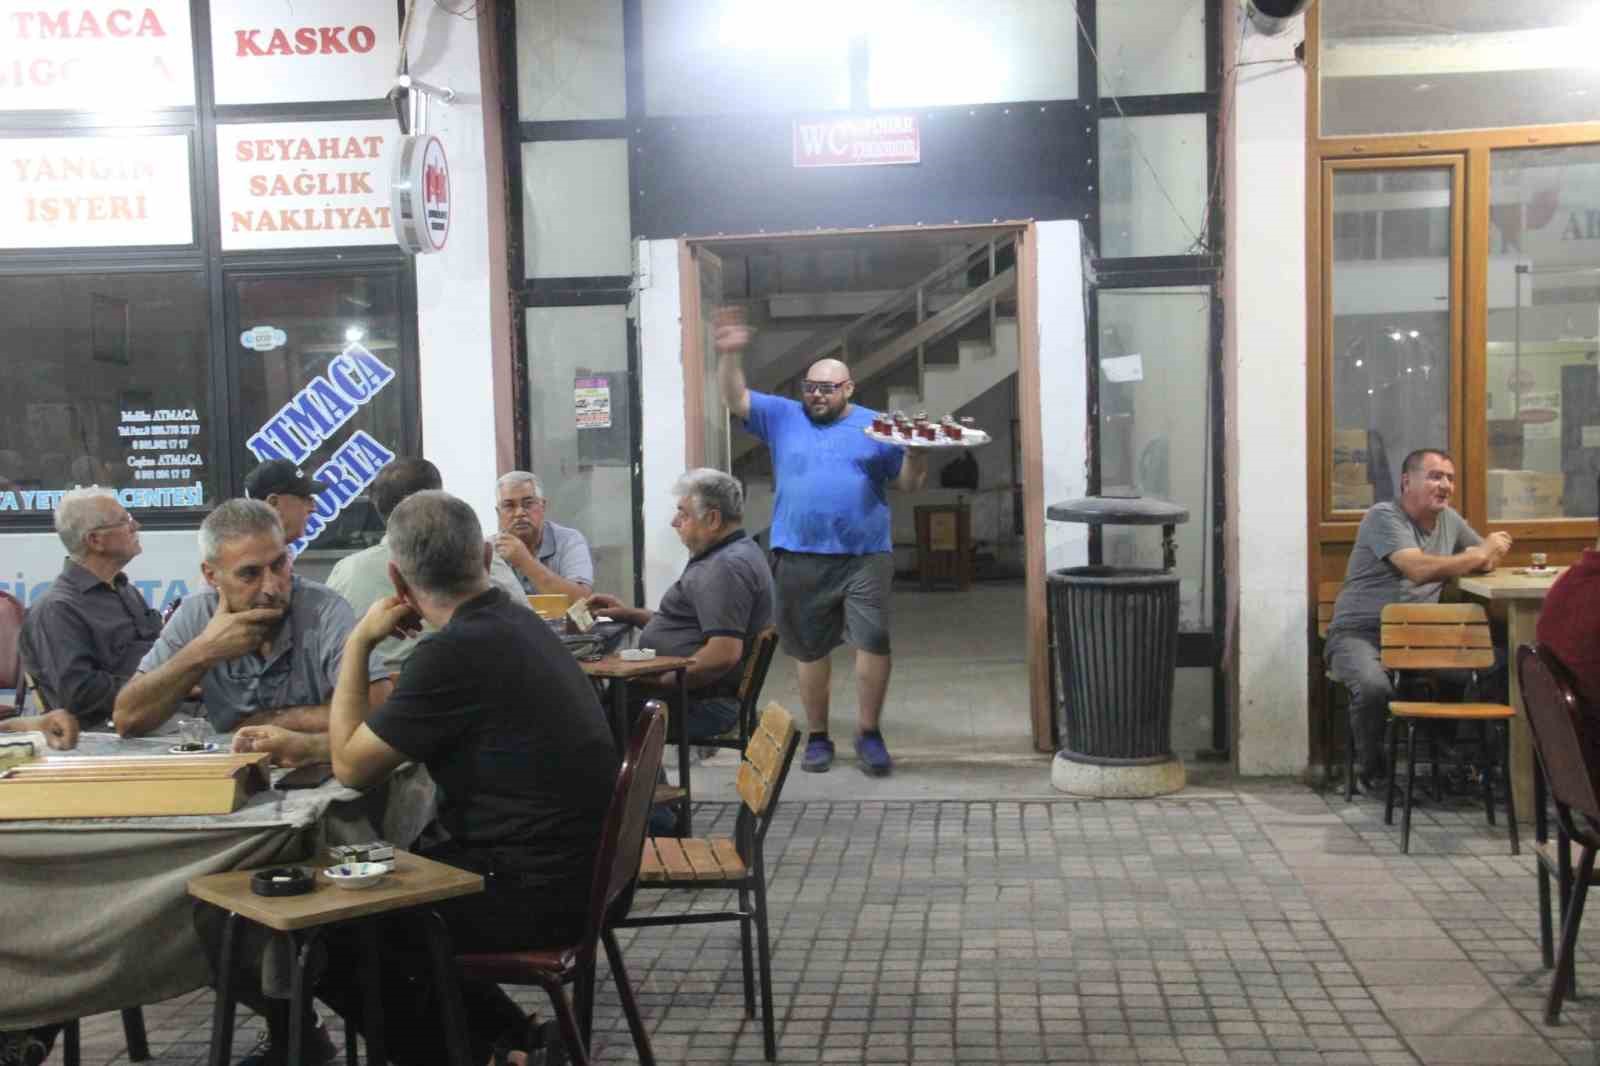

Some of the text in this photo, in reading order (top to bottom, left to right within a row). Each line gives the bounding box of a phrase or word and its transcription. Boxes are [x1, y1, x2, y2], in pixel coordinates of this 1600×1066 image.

[234, 25, 376, 57] KASKO
[236, 135, 384, 161] SEYAHAT
[800, 125, 849, 156] WC
[249, 168, 373, 196] SAĞLIK
[231, 203, 392, 232] NAKLİYAT
